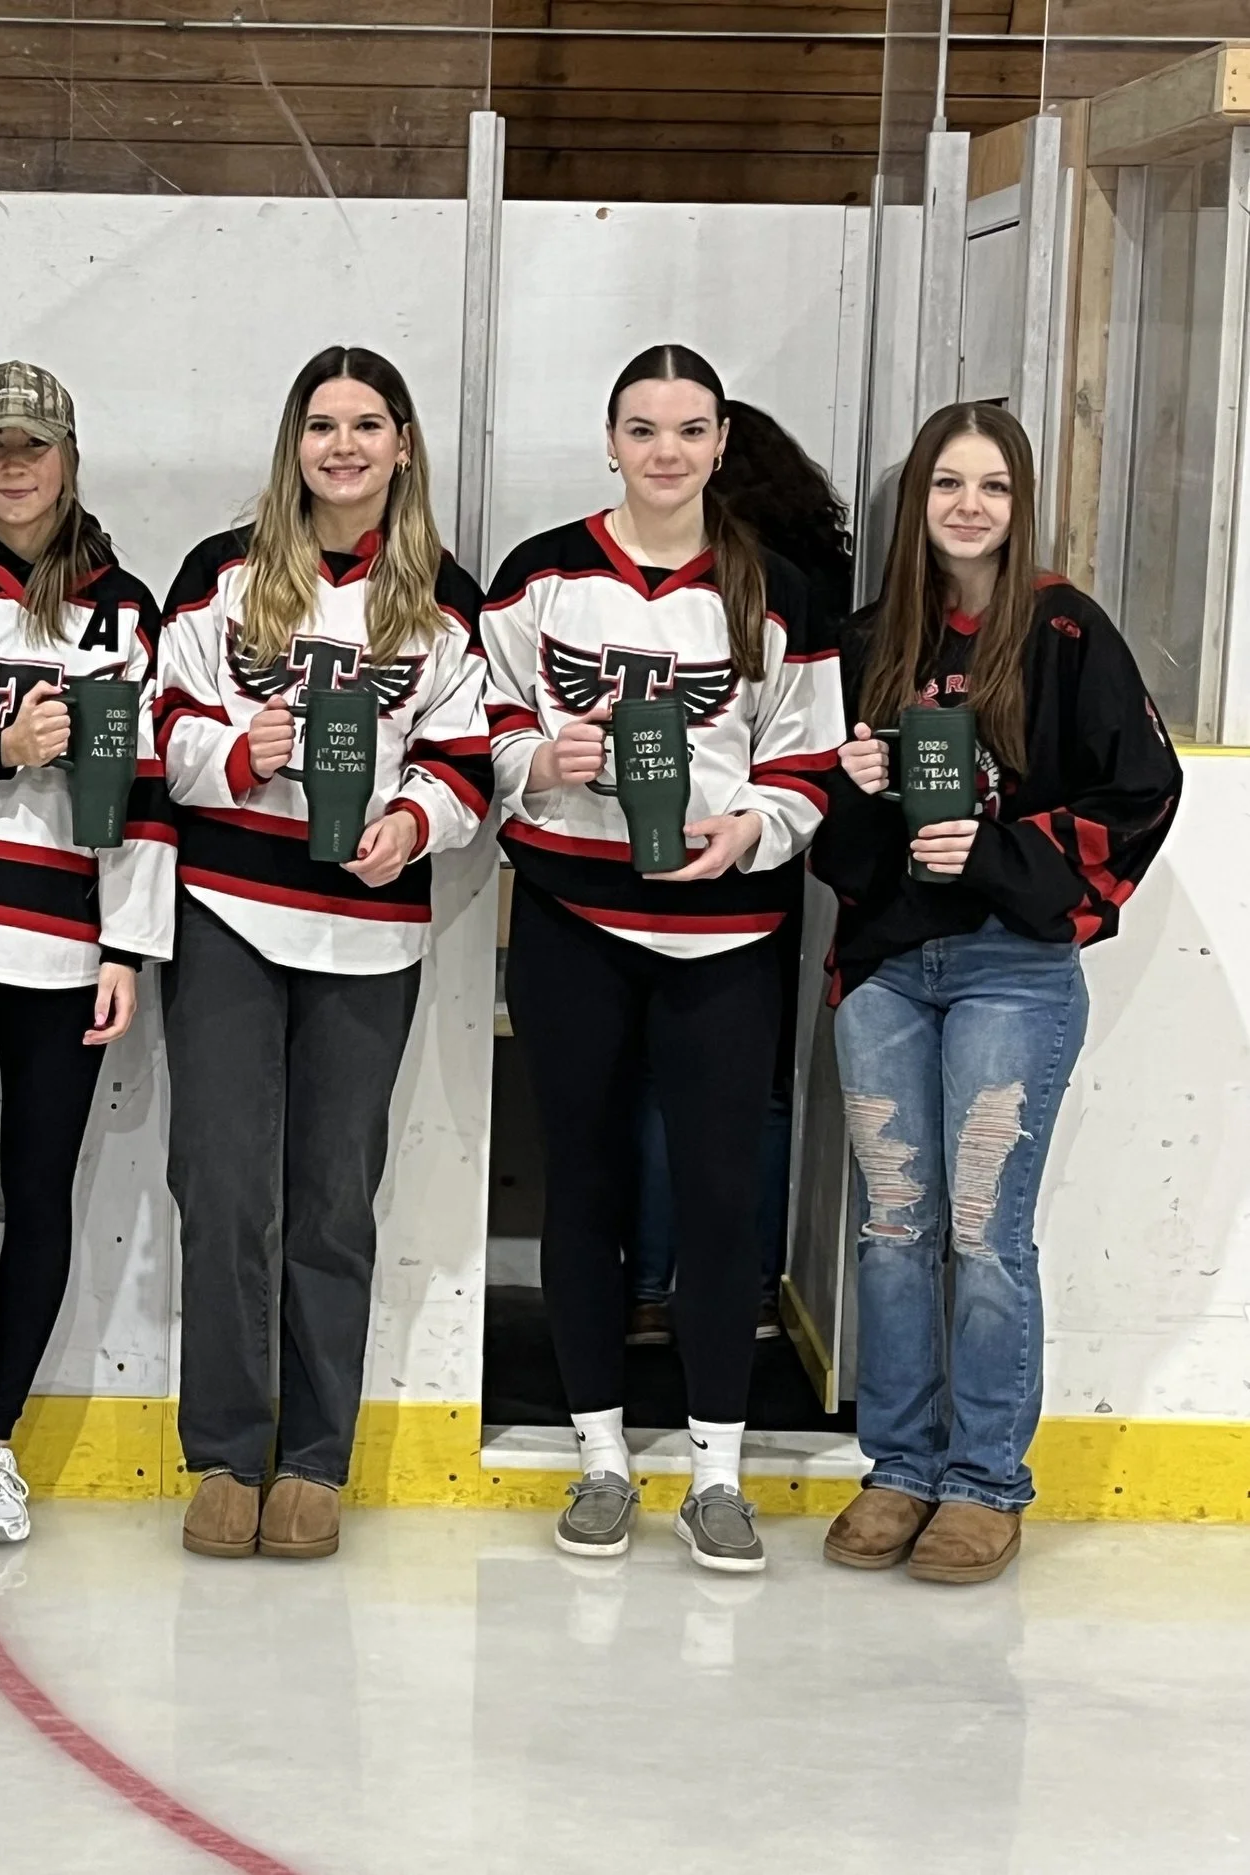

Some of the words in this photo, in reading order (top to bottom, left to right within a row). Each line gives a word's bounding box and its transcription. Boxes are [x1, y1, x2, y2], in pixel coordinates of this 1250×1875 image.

[78, 603, 119, 653] A
[287, 634, 364, 706] T
[599, 643, 678, 712] T
[327, 722, 358, 733] 2026
[329, 735, 355, 746] U20
[632, 730, 663, 742] 2026
[635, 743, 662, 755] U20
[917, 740, 949, 751] 2026
[91, 747, 114, 758] ALL
[331, 749, 367, 761] TEAM
[919, 753, 946, 764] U20
[639, 756, 676, 769] TEAM
[647, 768, 678, 780] STAR
[922, 767, 960, 778] TEAM
[929, 779, 961, 790] STAR
